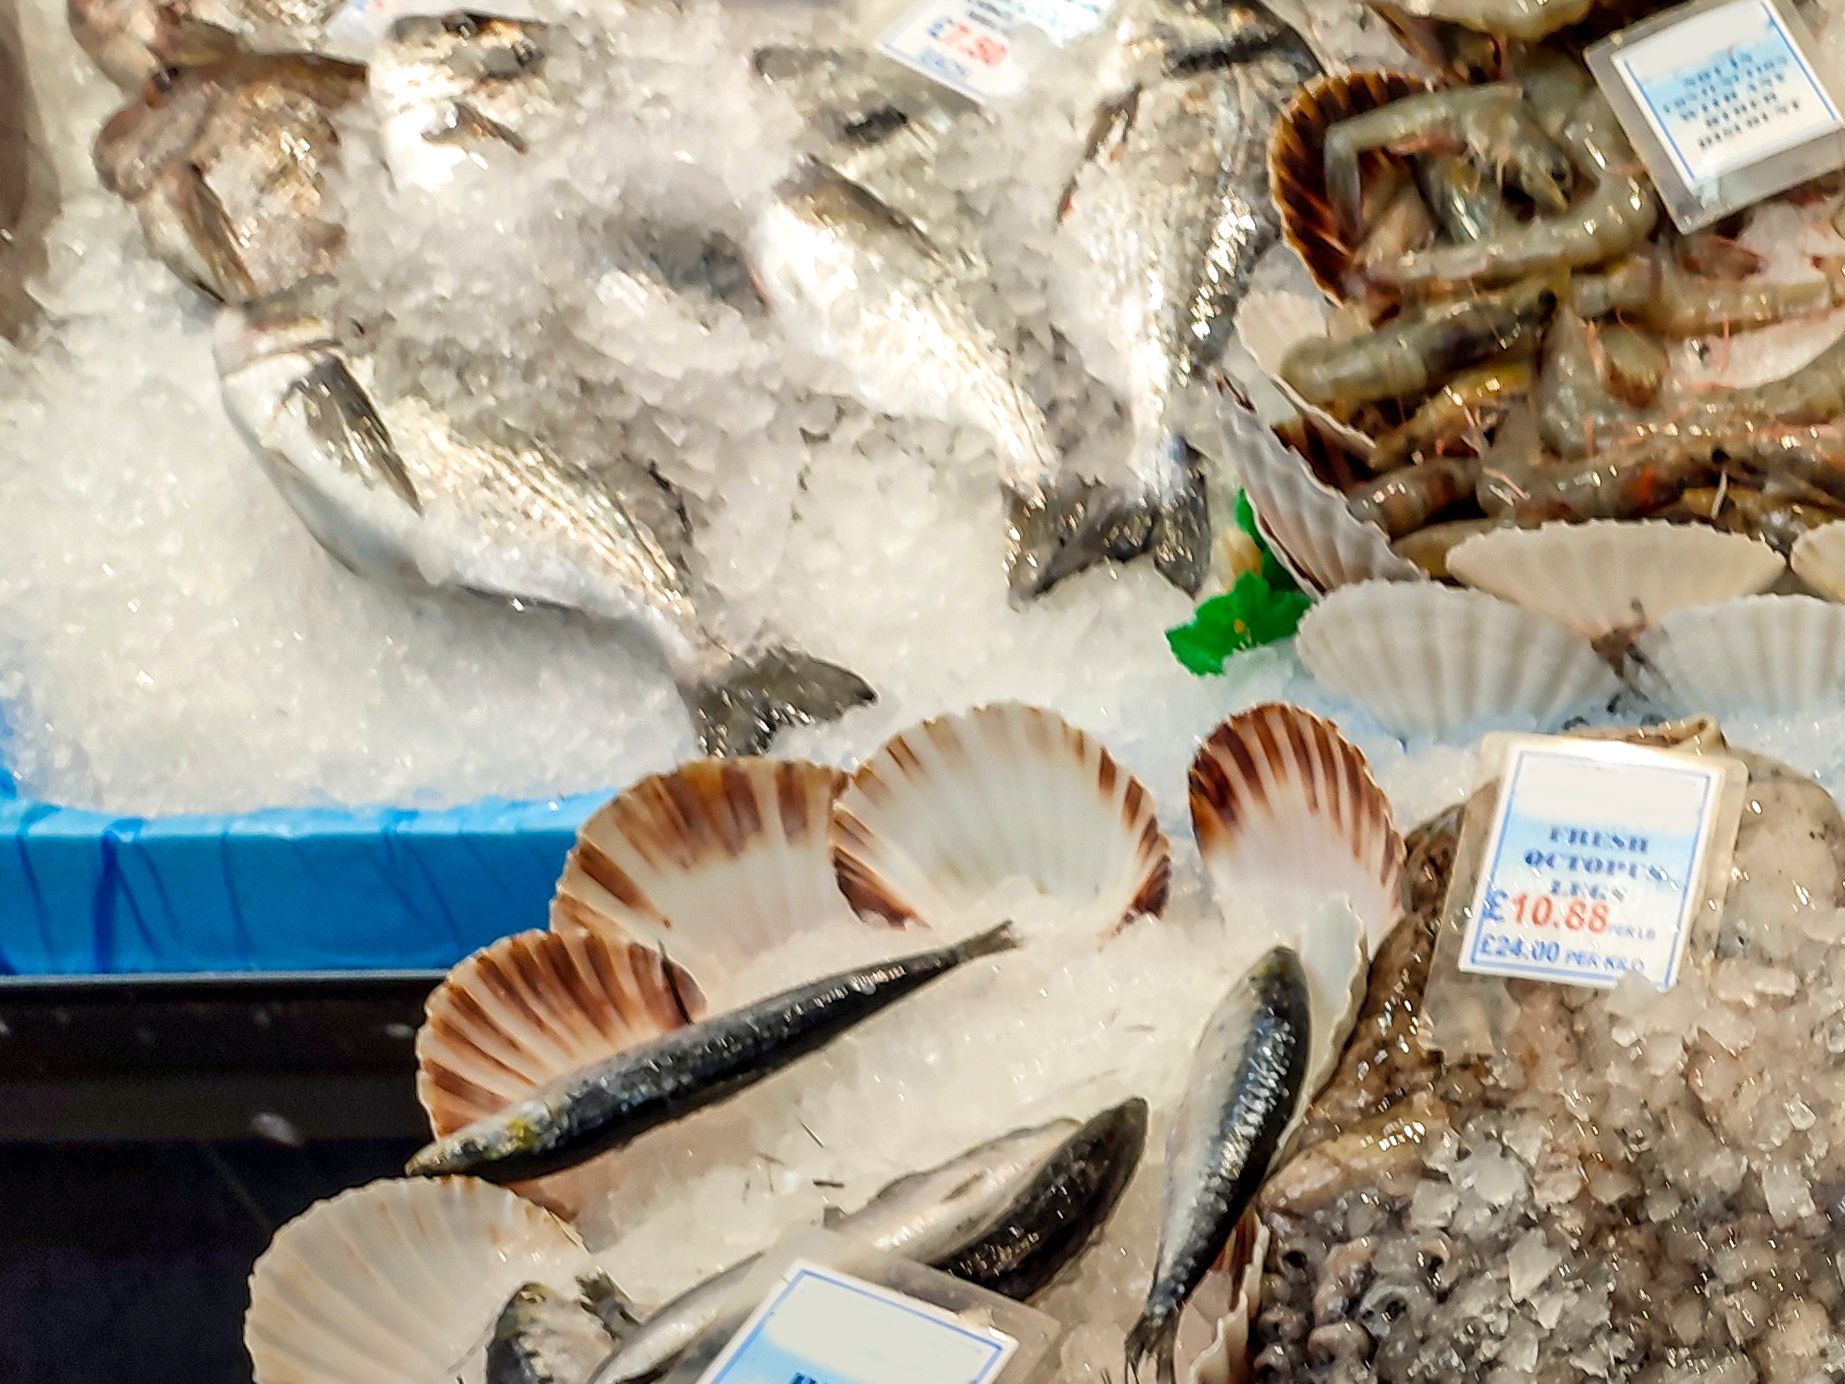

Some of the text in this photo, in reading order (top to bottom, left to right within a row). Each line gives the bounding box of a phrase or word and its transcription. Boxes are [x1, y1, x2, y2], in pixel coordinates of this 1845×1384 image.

[1550, 826, 1649, 853] FRESH
[1525, 849, 1672, 883] OCTOPUS
[1482, 889, 1611, 934] £10.88
[1480, 933, 1561, 964] £24.00
